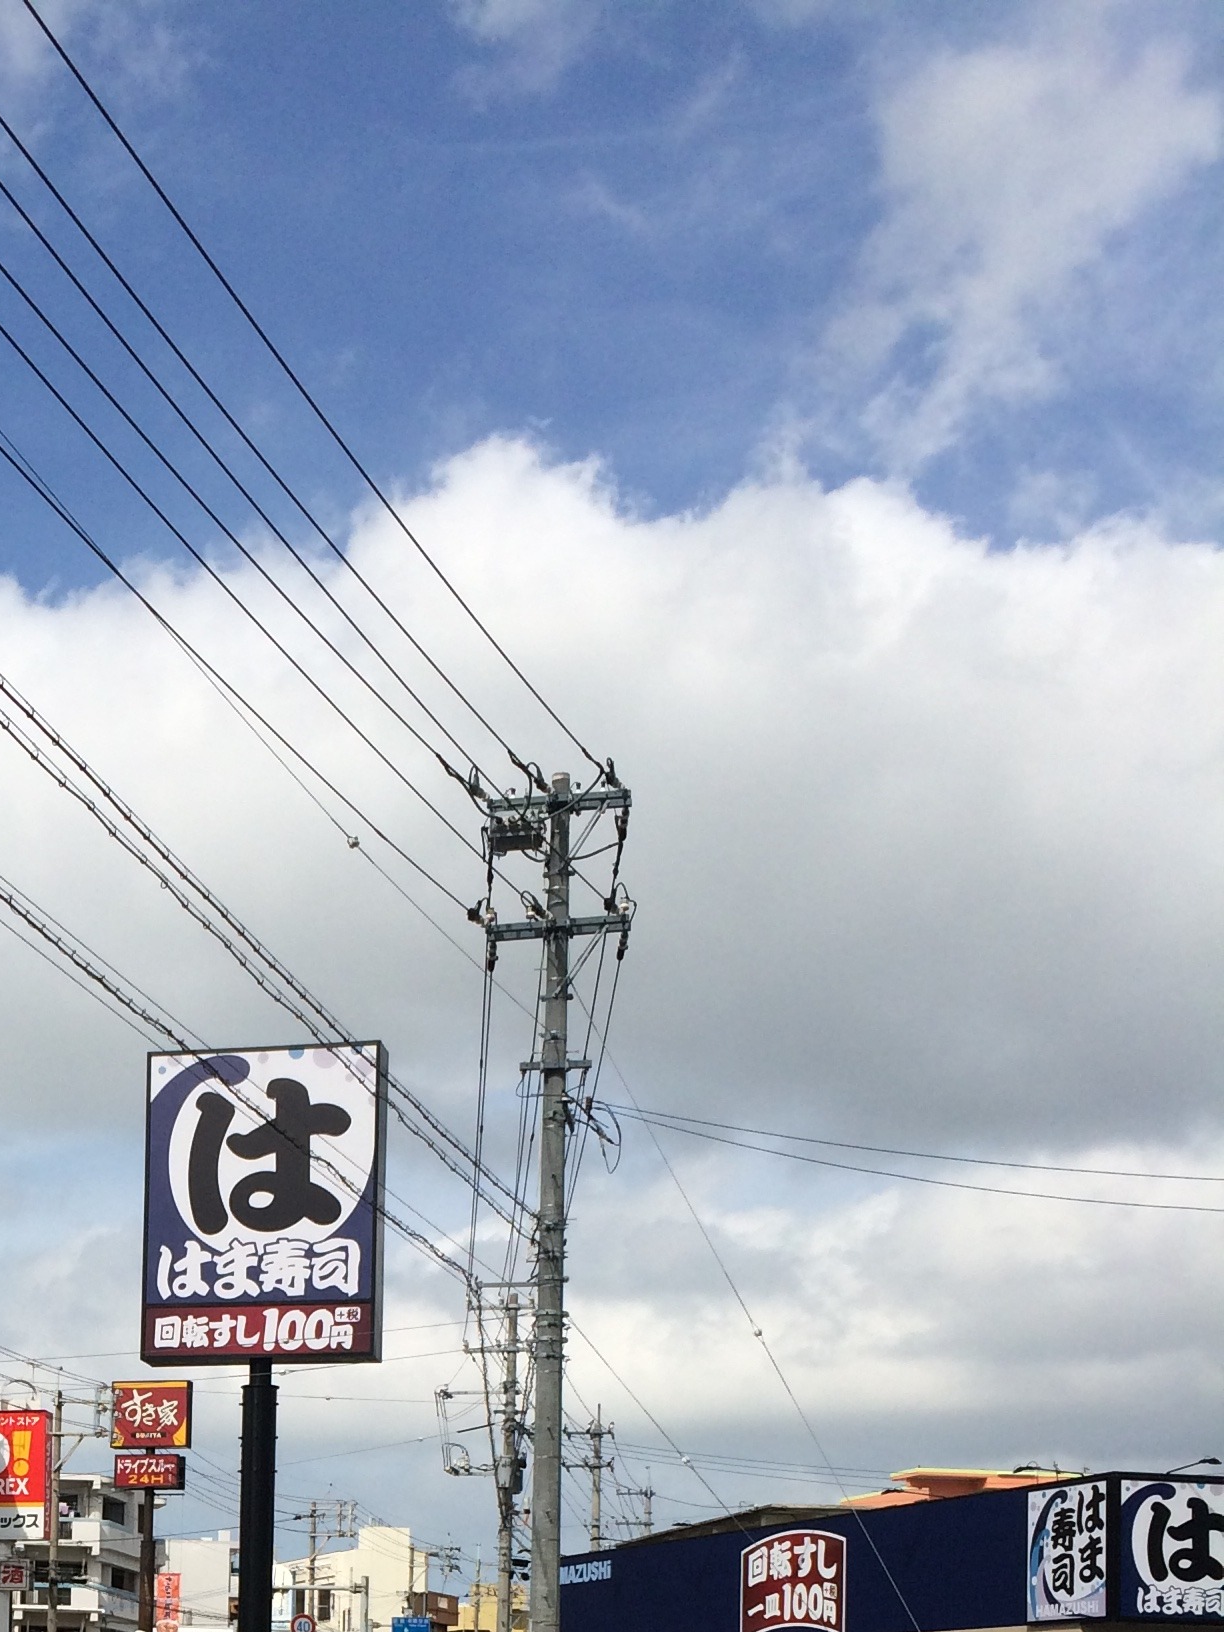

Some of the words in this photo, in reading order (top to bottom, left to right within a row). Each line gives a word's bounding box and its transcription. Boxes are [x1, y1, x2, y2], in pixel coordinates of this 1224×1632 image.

[188, 1078, 352, 1236] は
[156, 1237, 361, 1301] はま寿司
[121, 1389, 179, 1431] すき家
[128, 1474, 164, 1484] 24H
[1051, 1508, 1076, 1597] 寿司
[1077, 1485, 1105, 1584] はま
[1148, 1497, 1224, 1582] は
[1, 1565, 25, 1584] 酒
[748, 1537, 837, 1587] 回転すし
[1137, 1585, 1224, 1616] はま寿司
[296, 1621, 311, 1632] 40
